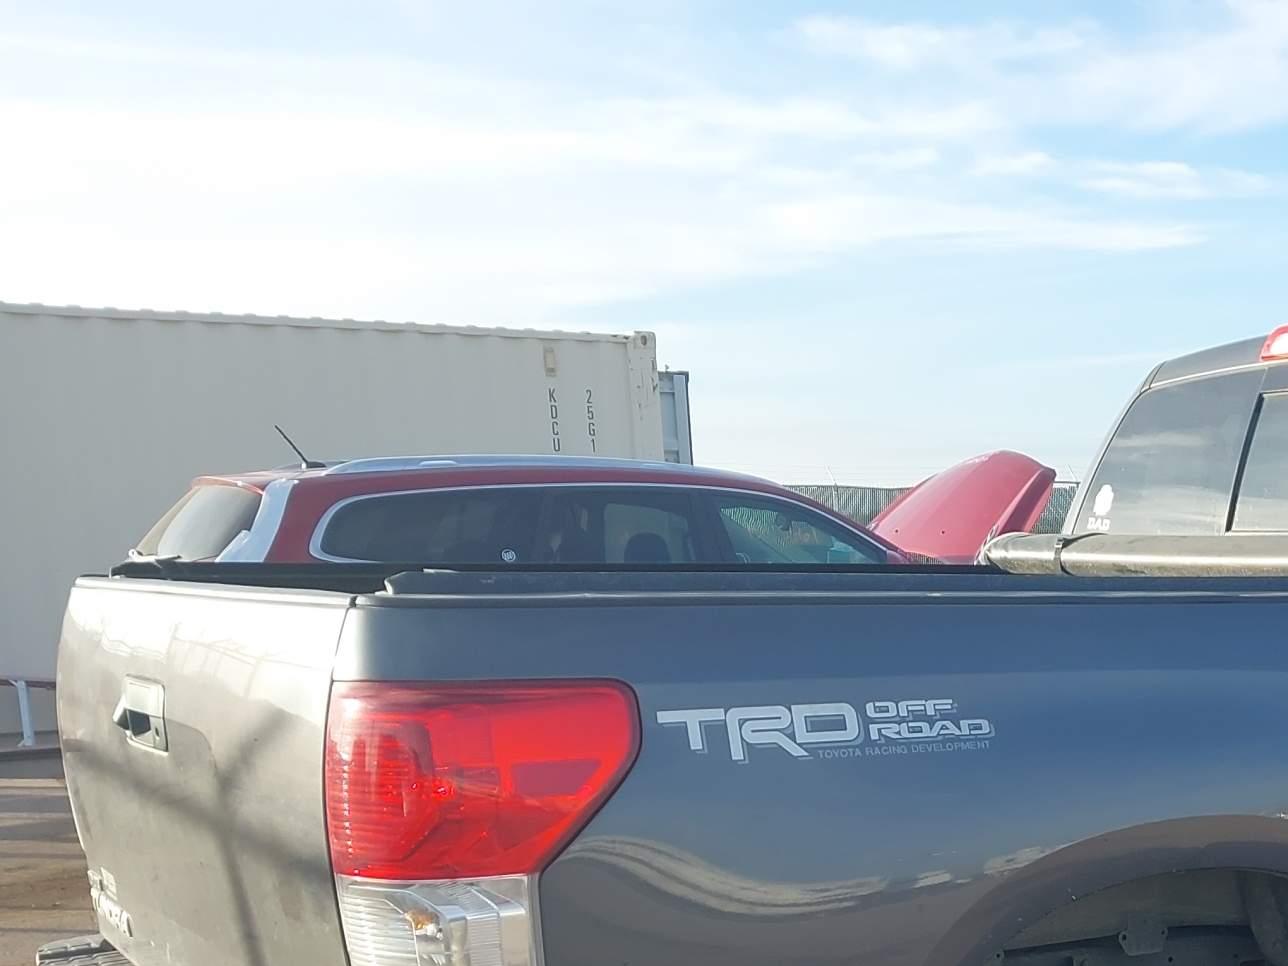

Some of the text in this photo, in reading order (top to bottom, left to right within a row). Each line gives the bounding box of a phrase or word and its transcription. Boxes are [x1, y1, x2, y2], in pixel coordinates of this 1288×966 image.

[548, 387, 561, 453] KDCU
[585, 388, 596, 453] 25G1
[1086, 516, 1111, 531] DAD
[865, 698, 957, 719] OFF
[656, 702, 863, 763] TRD
[868, 719, 995, 742] ROAD
[818, 739, 991, 760] TOYOTA RACING DEVELOPMENT
